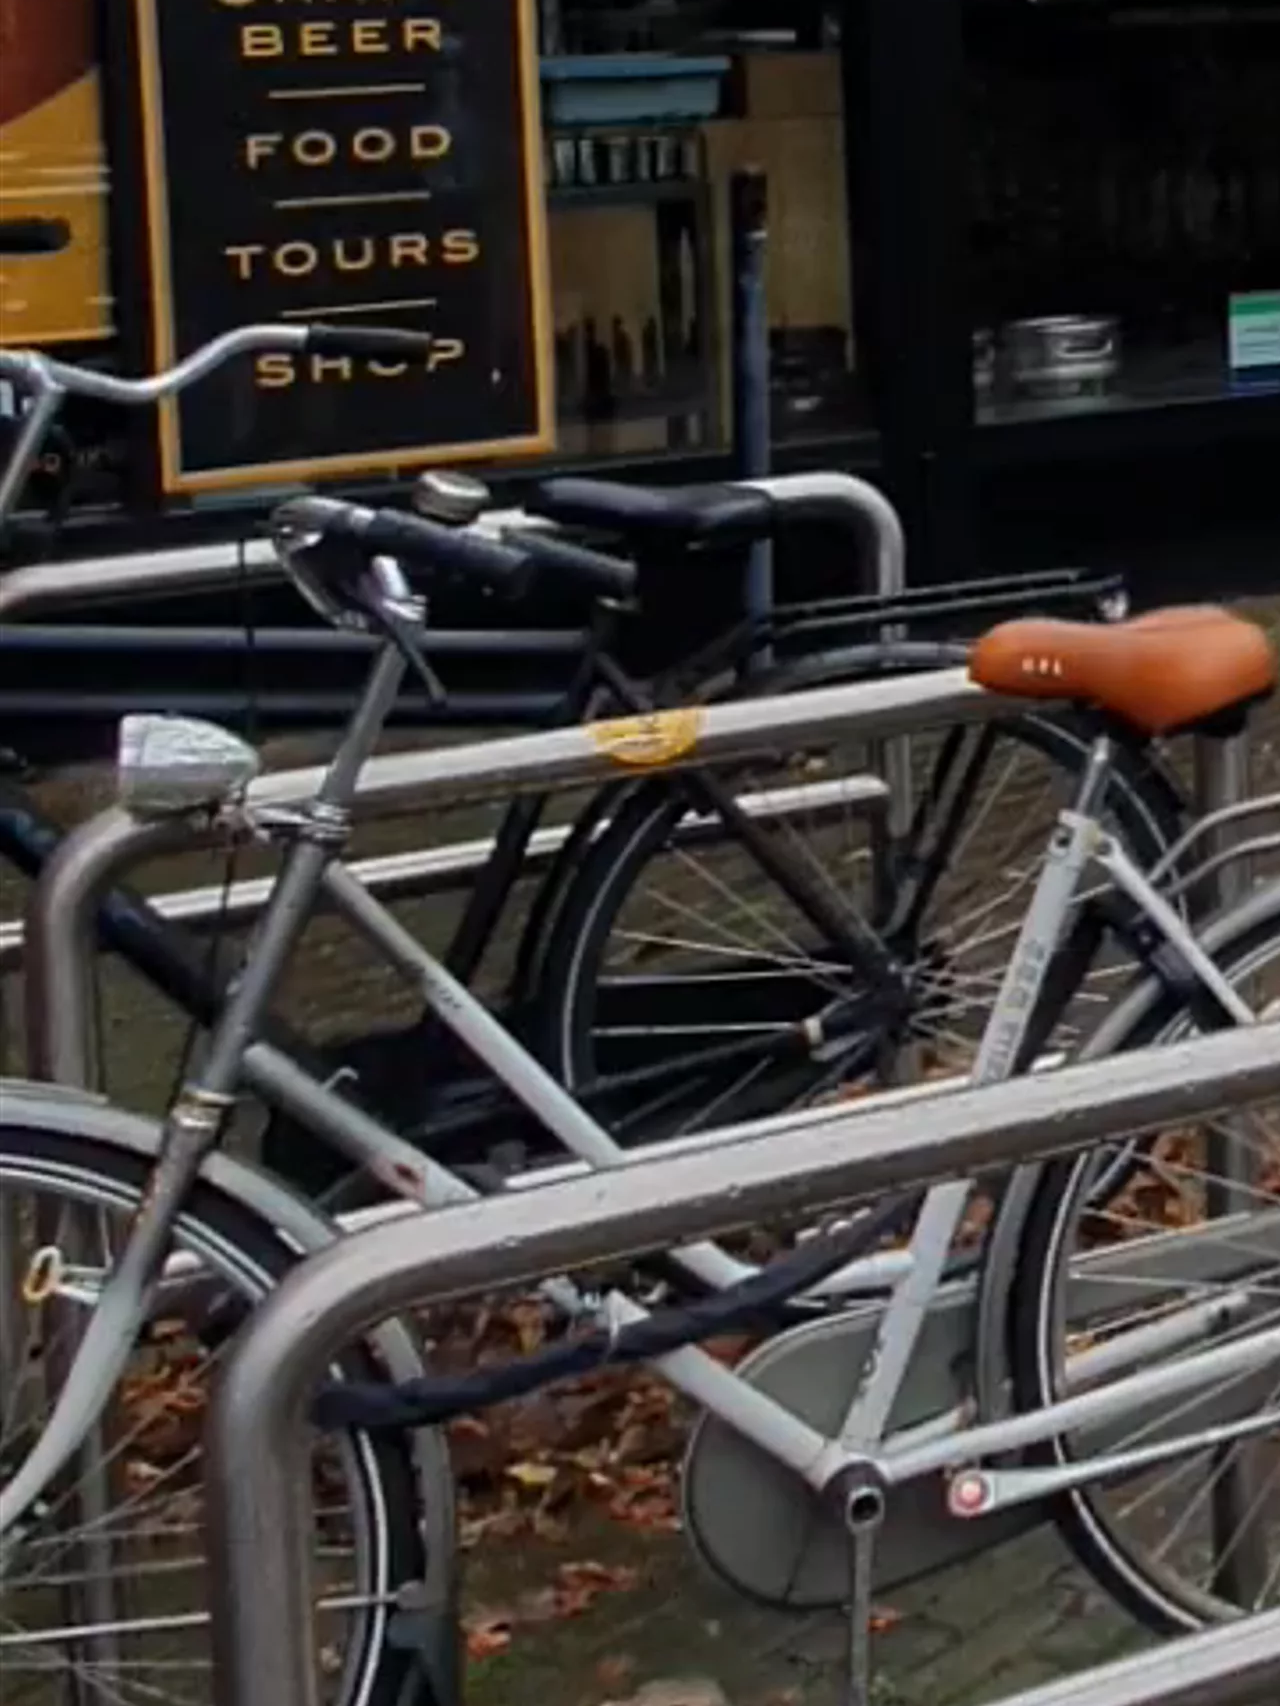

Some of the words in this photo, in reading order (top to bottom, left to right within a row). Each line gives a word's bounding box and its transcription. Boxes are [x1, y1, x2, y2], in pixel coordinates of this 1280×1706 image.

[242, 18, 442, 57] BEER
[246, 124, 451, 170] FOOD
[224, 229, 480, 280] TOURS
